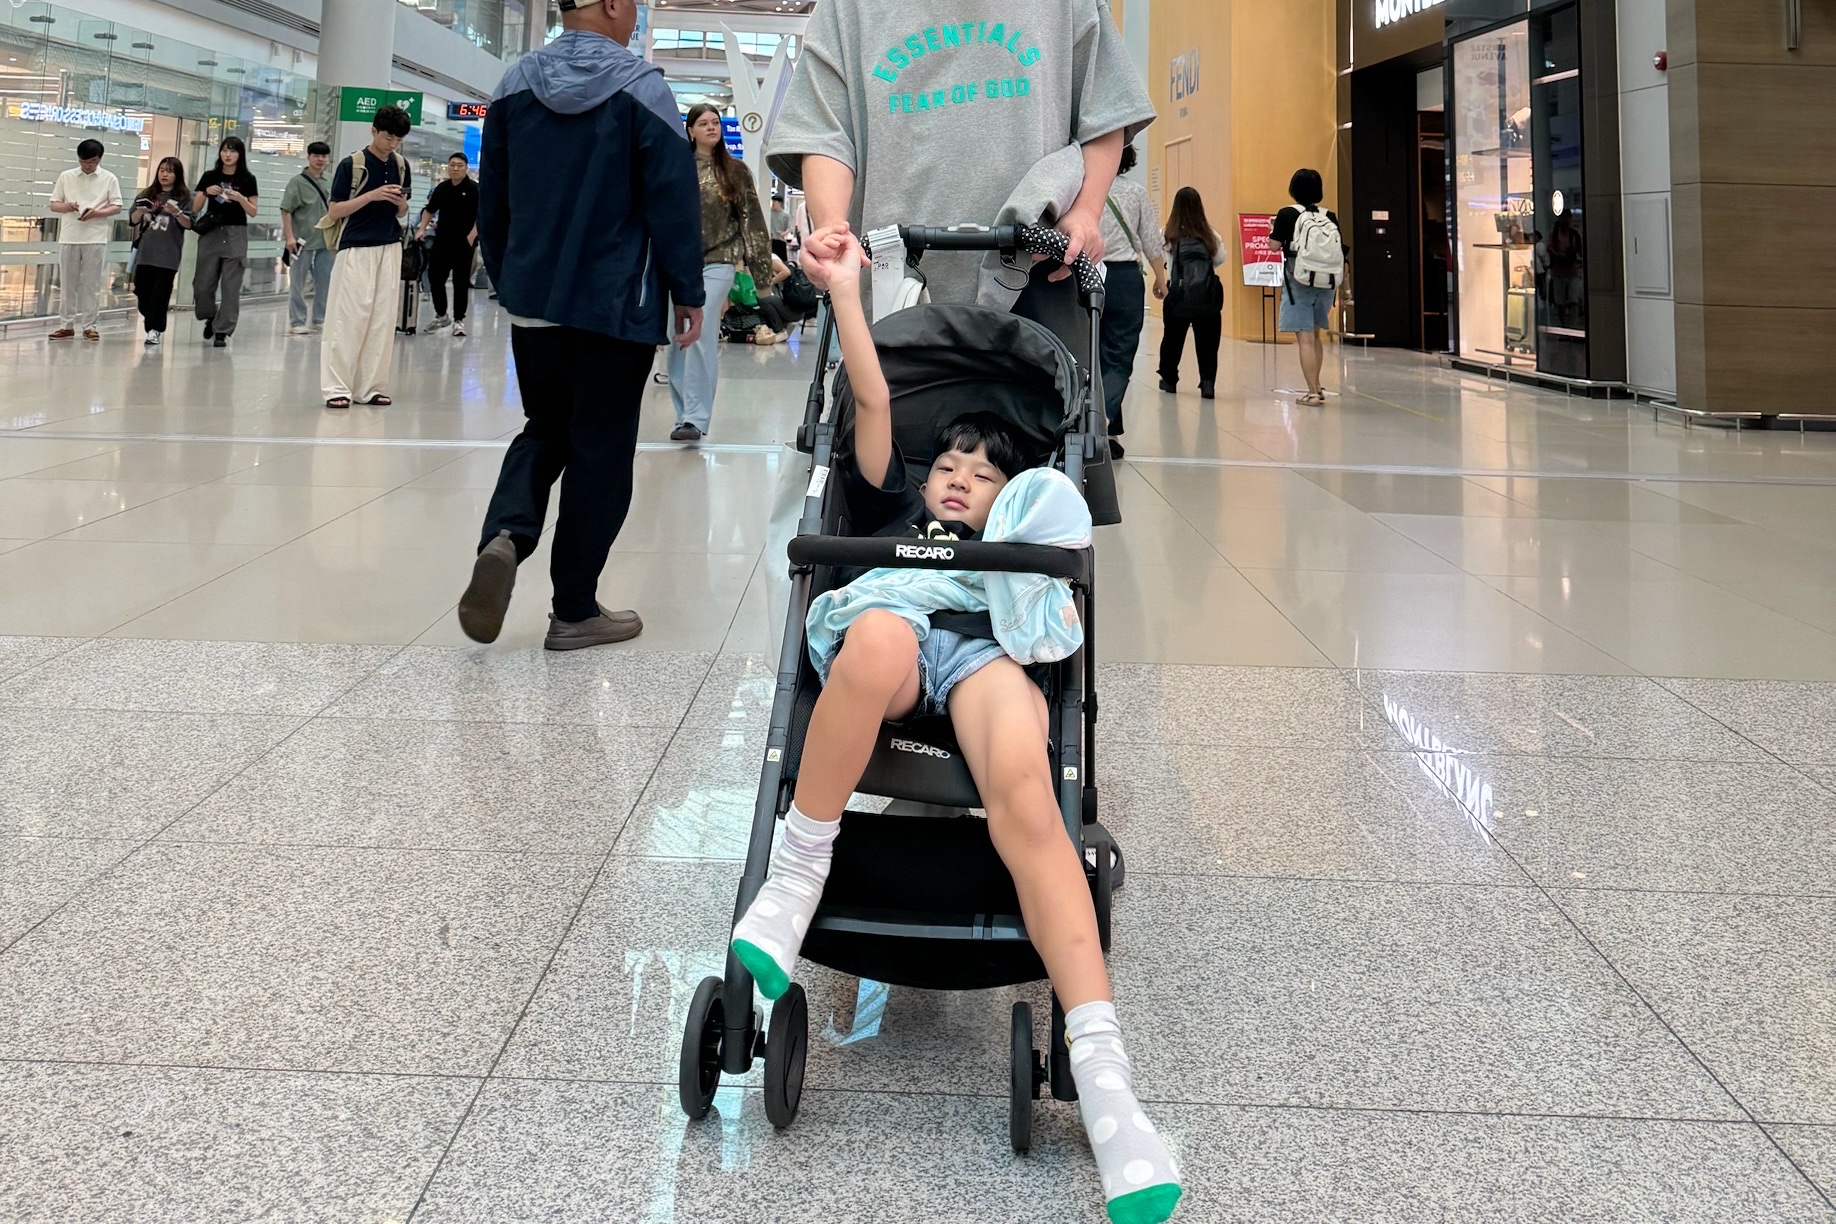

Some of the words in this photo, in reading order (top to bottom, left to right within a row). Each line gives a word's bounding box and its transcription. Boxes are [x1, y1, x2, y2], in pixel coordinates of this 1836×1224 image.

[872, 20, 1041, 84] ESSENTIALS
[1169, 47, 1200, 104] FENDI
[356, 96, 377, 106] AED
[889, 89, 945, 114] FEAR
[952, 82, 978, 104] OF
[985, 77, 1030, 99] GOD
[459, 103, 488, 117] 6:46
[895, 543, 955, 561] RECARO
[890, 737, 952, 760] RECARO
